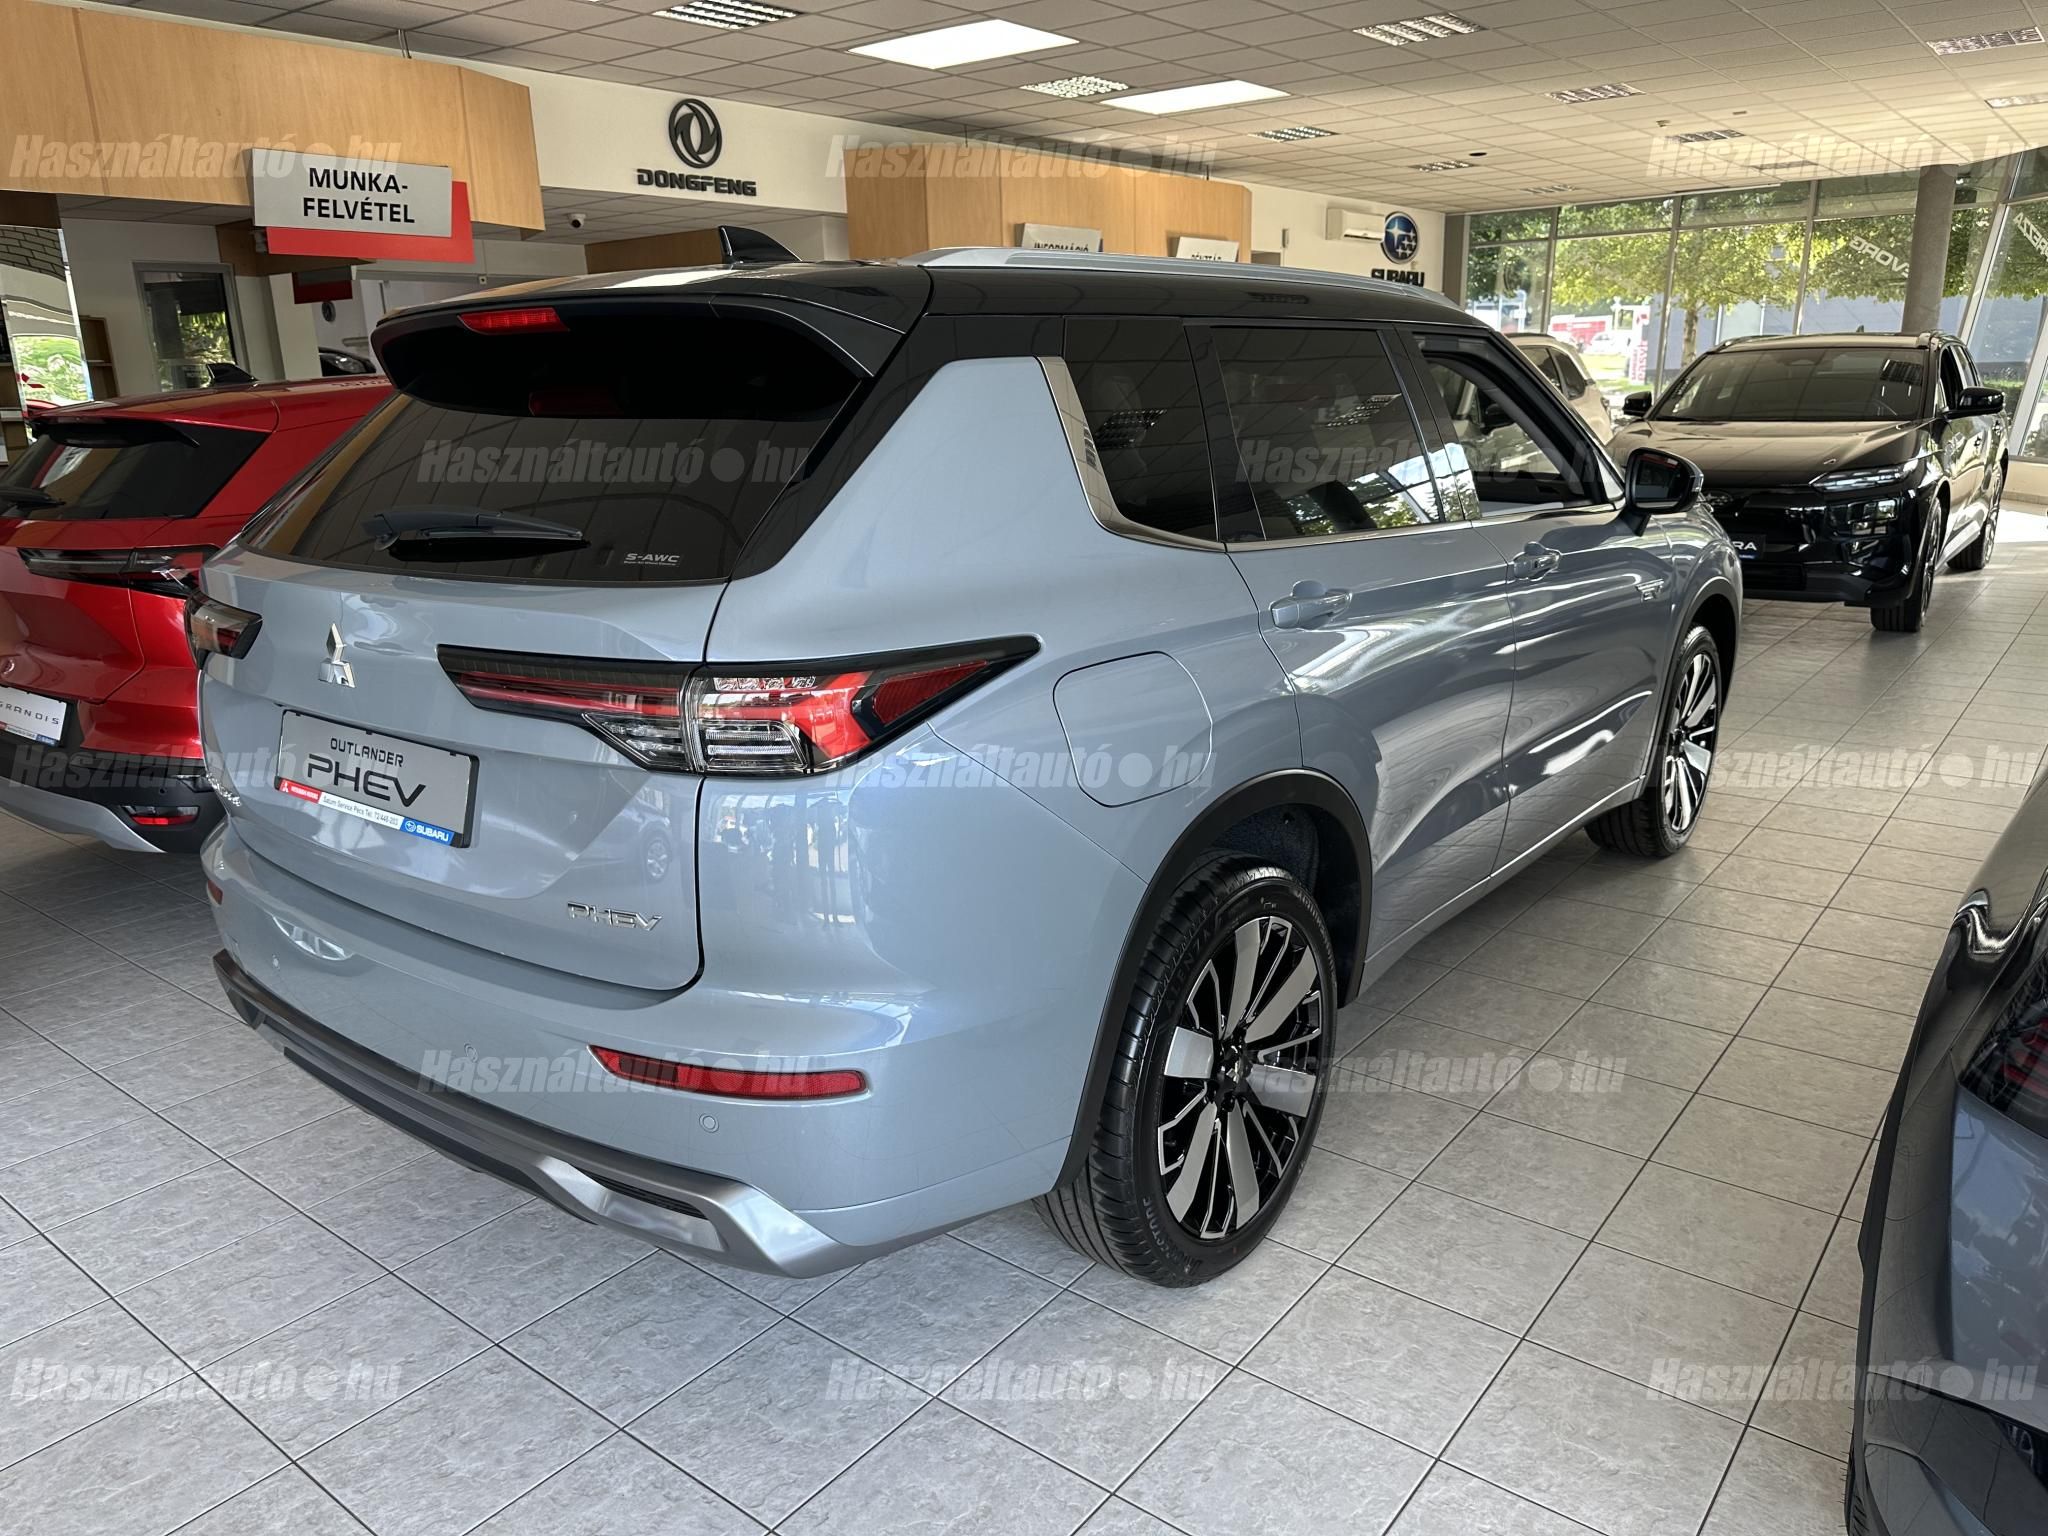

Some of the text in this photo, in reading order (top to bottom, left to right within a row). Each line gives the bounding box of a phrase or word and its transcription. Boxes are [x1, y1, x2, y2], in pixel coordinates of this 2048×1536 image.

[309, 167, 408, 193] MUNKA-
[637, 168, 756, 196] DONGFENG
[303, 197, 415, 223] FELVÉTEL
[1371, 268, 1425, 288] SUBARU
[625, 553, 681, 563] S-AWC
[330, 737, 404, 767] OUTLANDER
[307, 753, 427, 808] PHEV
[416, 824, 449, 842] SUBARU
[568, 902, 662, 931] PHEV
